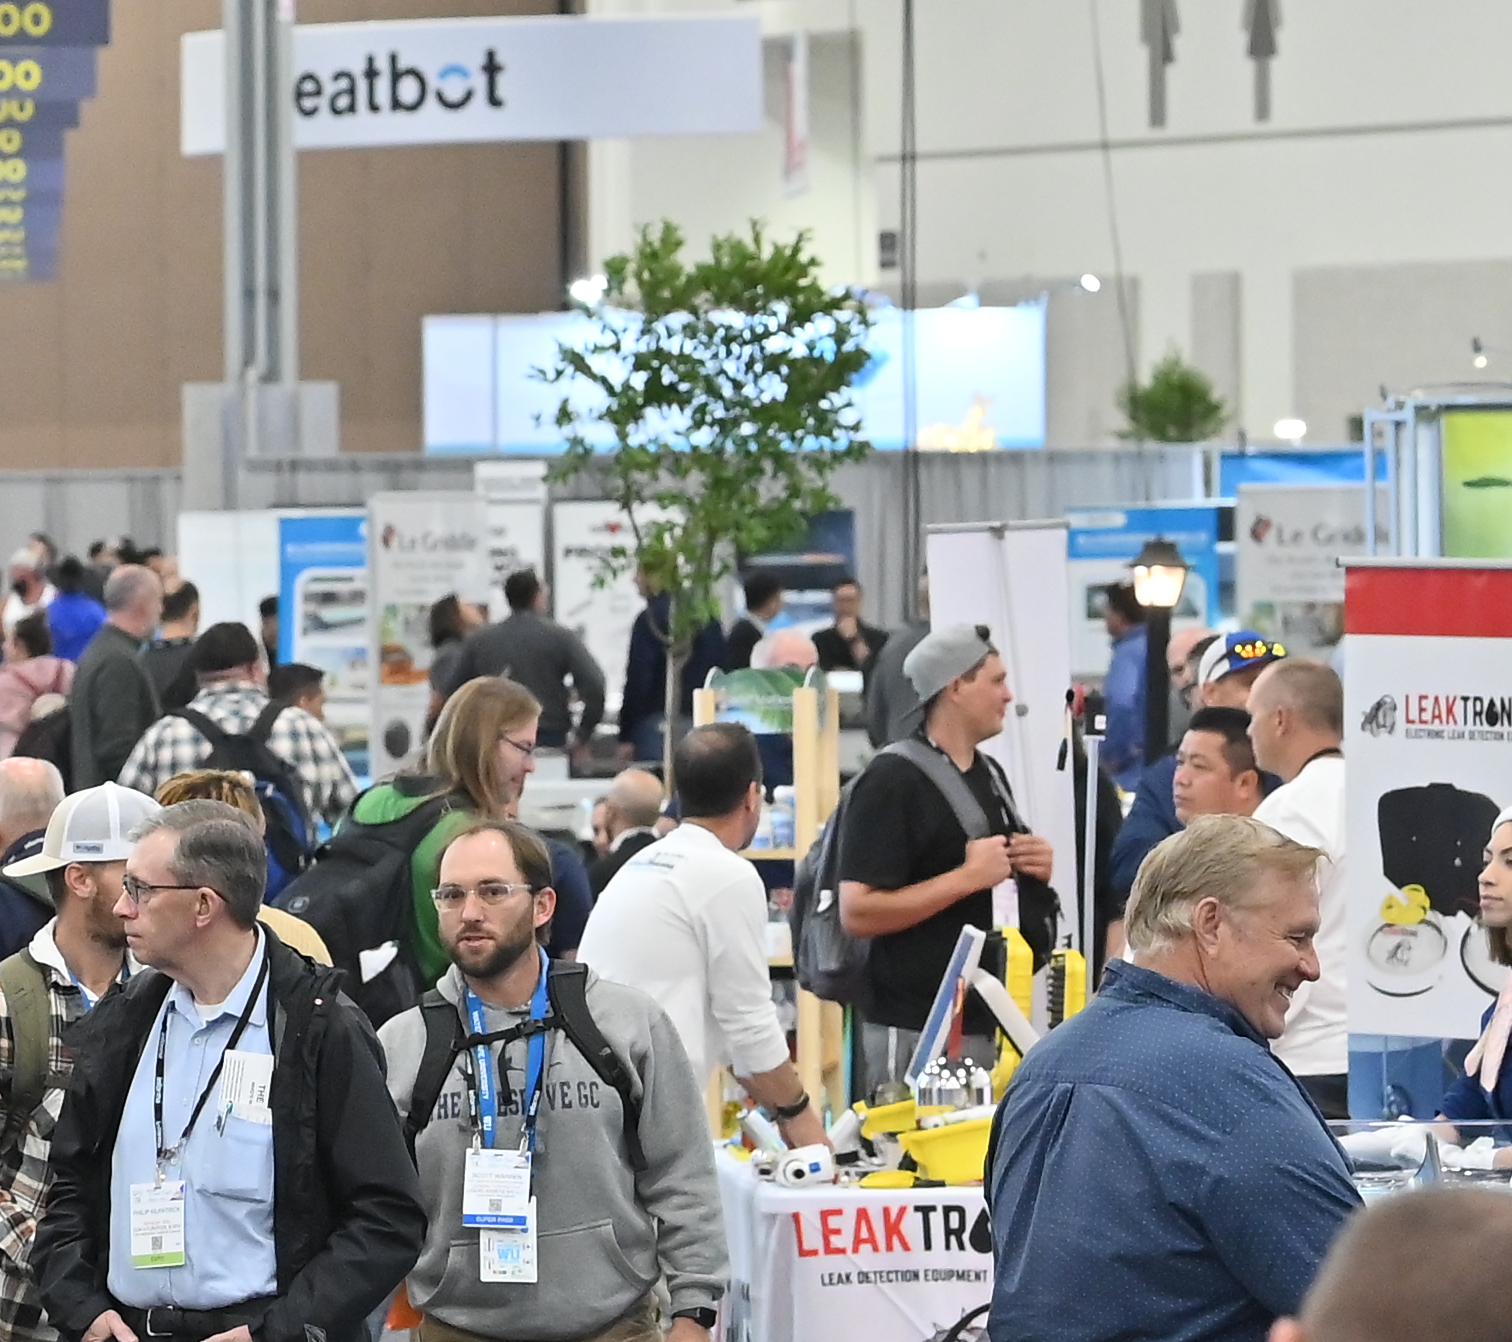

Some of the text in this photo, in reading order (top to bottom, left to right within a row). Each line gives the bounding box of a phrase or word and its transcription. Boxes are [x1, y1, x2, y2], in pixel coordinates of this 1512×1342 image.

[1447, 729, 1465, 740] LEAK
[1468, 730, 1504, 741] DETECTION
[821, 1269, 988, 1287] LEAK DETECTION EQUIPMENT
